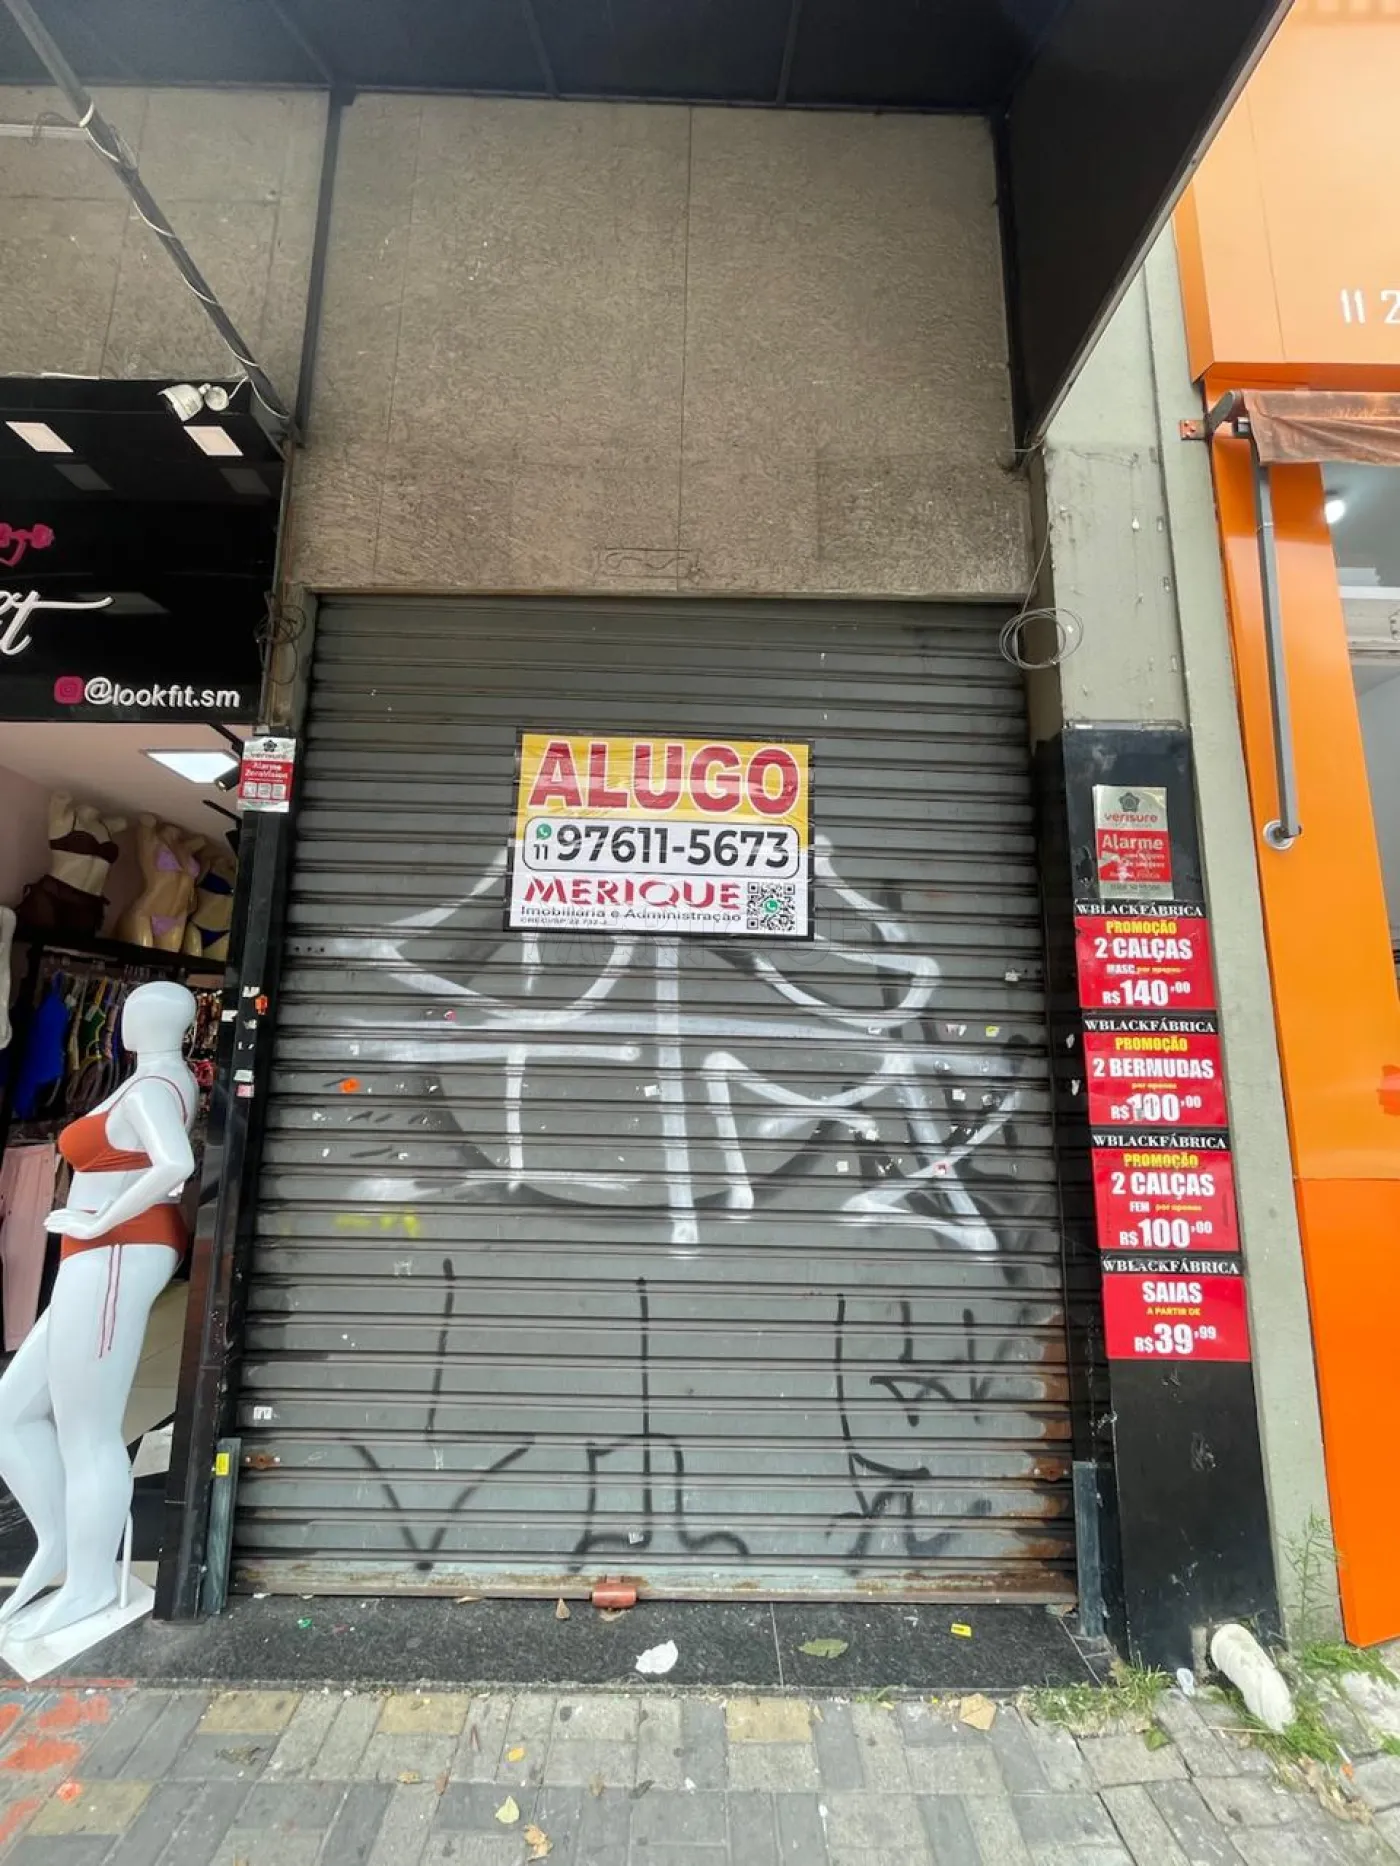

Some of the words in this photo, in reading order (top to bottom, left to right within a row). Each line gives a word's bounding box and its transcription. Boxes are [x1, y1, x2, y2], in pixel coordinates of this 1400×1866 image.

[84, 676, 241, 708] @lookfit.sm
[527, 740, 801, 817] ALUGO
[533, 843, 548, 861] 11
[556, 824, 789, 869] 97611-5673
[1102, 833, 1164, 851] Alarme
[524, 876, 741, 911] MERIQUE
[610, 909, 620, 918] e
[623, 908, 742, 924] Administração
[1076, 902, 1203, 917] WBLACKFÁBRICA
[1106, 919, 1177, 936] PROMOÇÃO
[1094, 937, 1108, 959] 2
[1113, 937, 1193, 962] CALÇAS
[1085, 1017, 1215, 1033] WBLACKFÁBRICA
[1115, 1035, 1188, 1054] PROMOÇÃO
[1093, 1058, 1105, 1077] 2
[1109, 1057, 1214, 1079] BERMUDAS
[1092, 1133, 1226, 1149] WBLACKFÁBRICA
[1123, 1152, 1199, 1170] PROMOÇÃO
[1111, 1172, 1126, 1195] 2
[1130, 1172, 1215, 1200] CALÇAS
[1129, 1201, 1150, 1213] FEM
[1102, 1258, 1239, 1274] WBLACKFÁBRICA
[1142, 1281, 1203, 1304] SAIAS
[1134, 1336, 1154, 1353] R$
